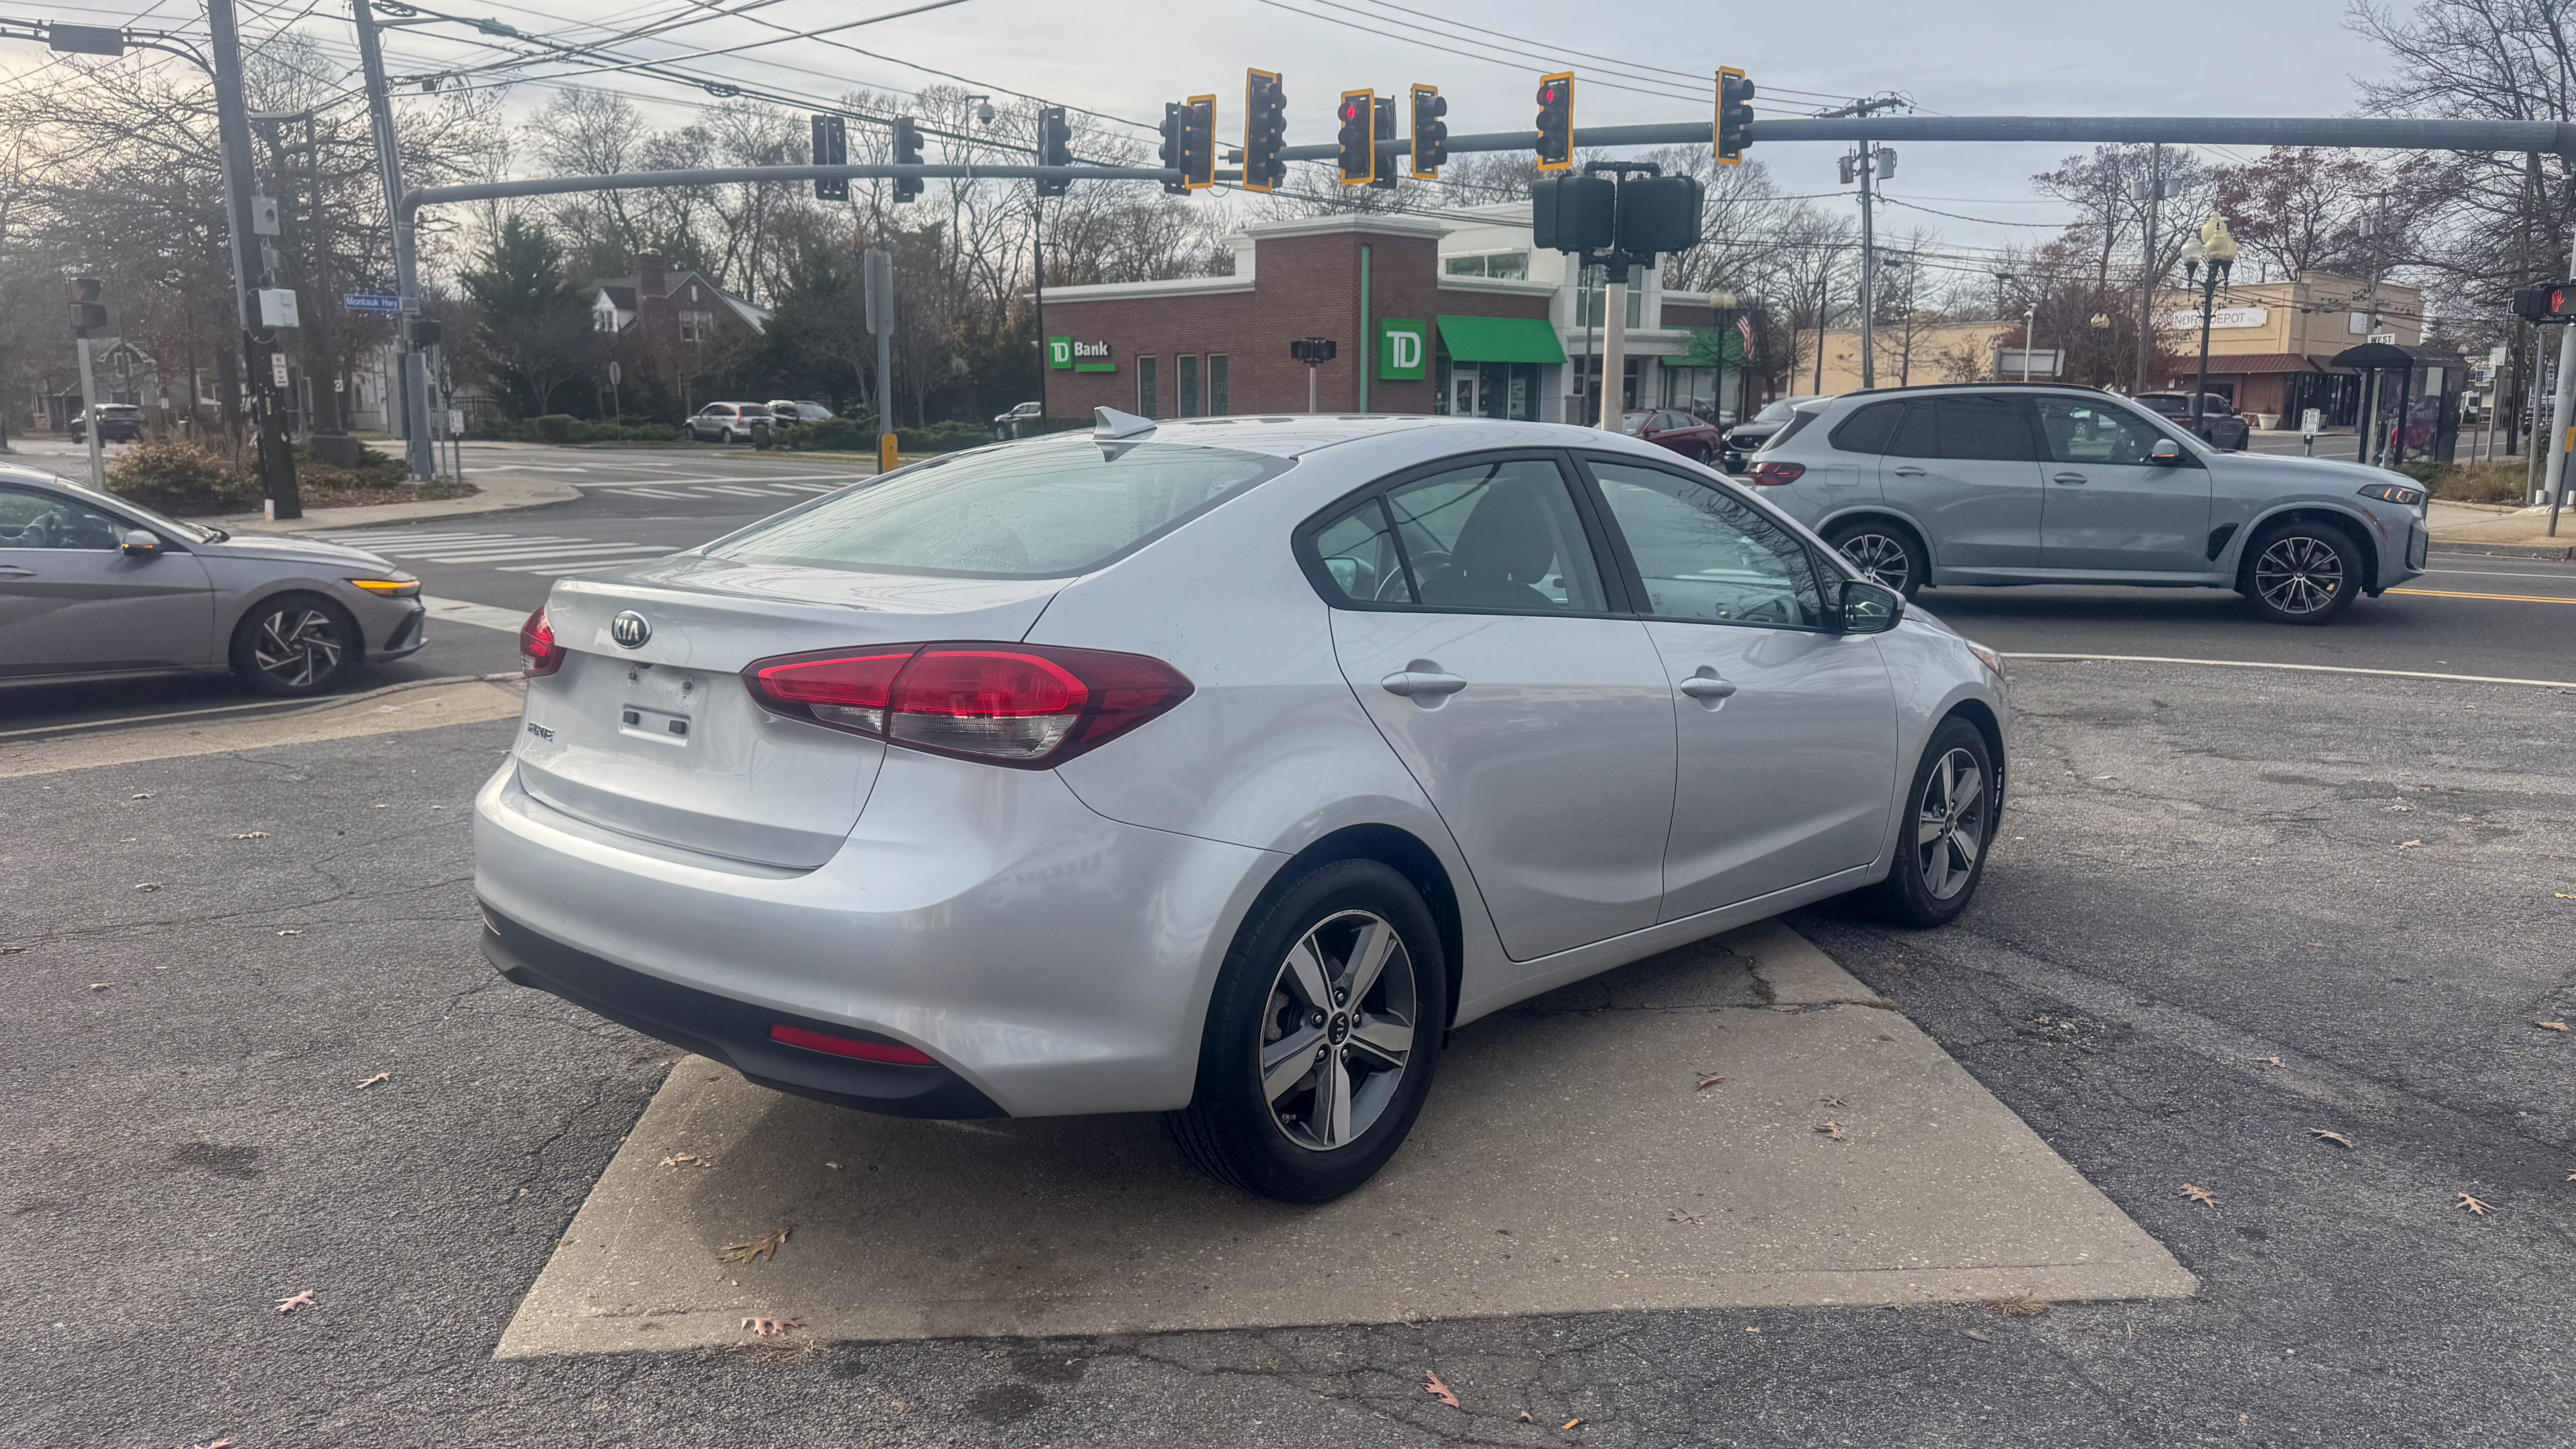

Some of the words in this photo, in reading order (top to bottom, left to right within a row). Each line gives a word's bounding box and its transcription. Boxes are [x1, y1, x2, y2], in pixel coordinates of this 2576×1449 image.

[346, 297, 379, 306] Montauk
[381, 298, 397, 309] Hwy
[1386, 331, 1421, 368] TD
[2371, 335, 2392, 344] WEST
[1051, 342, 1069, 362] TD
[1074, 340, 1108, 356] Bank
[614, 618, 640, 641] KIA
[1335, 1016, 1344, 1042] KIA
